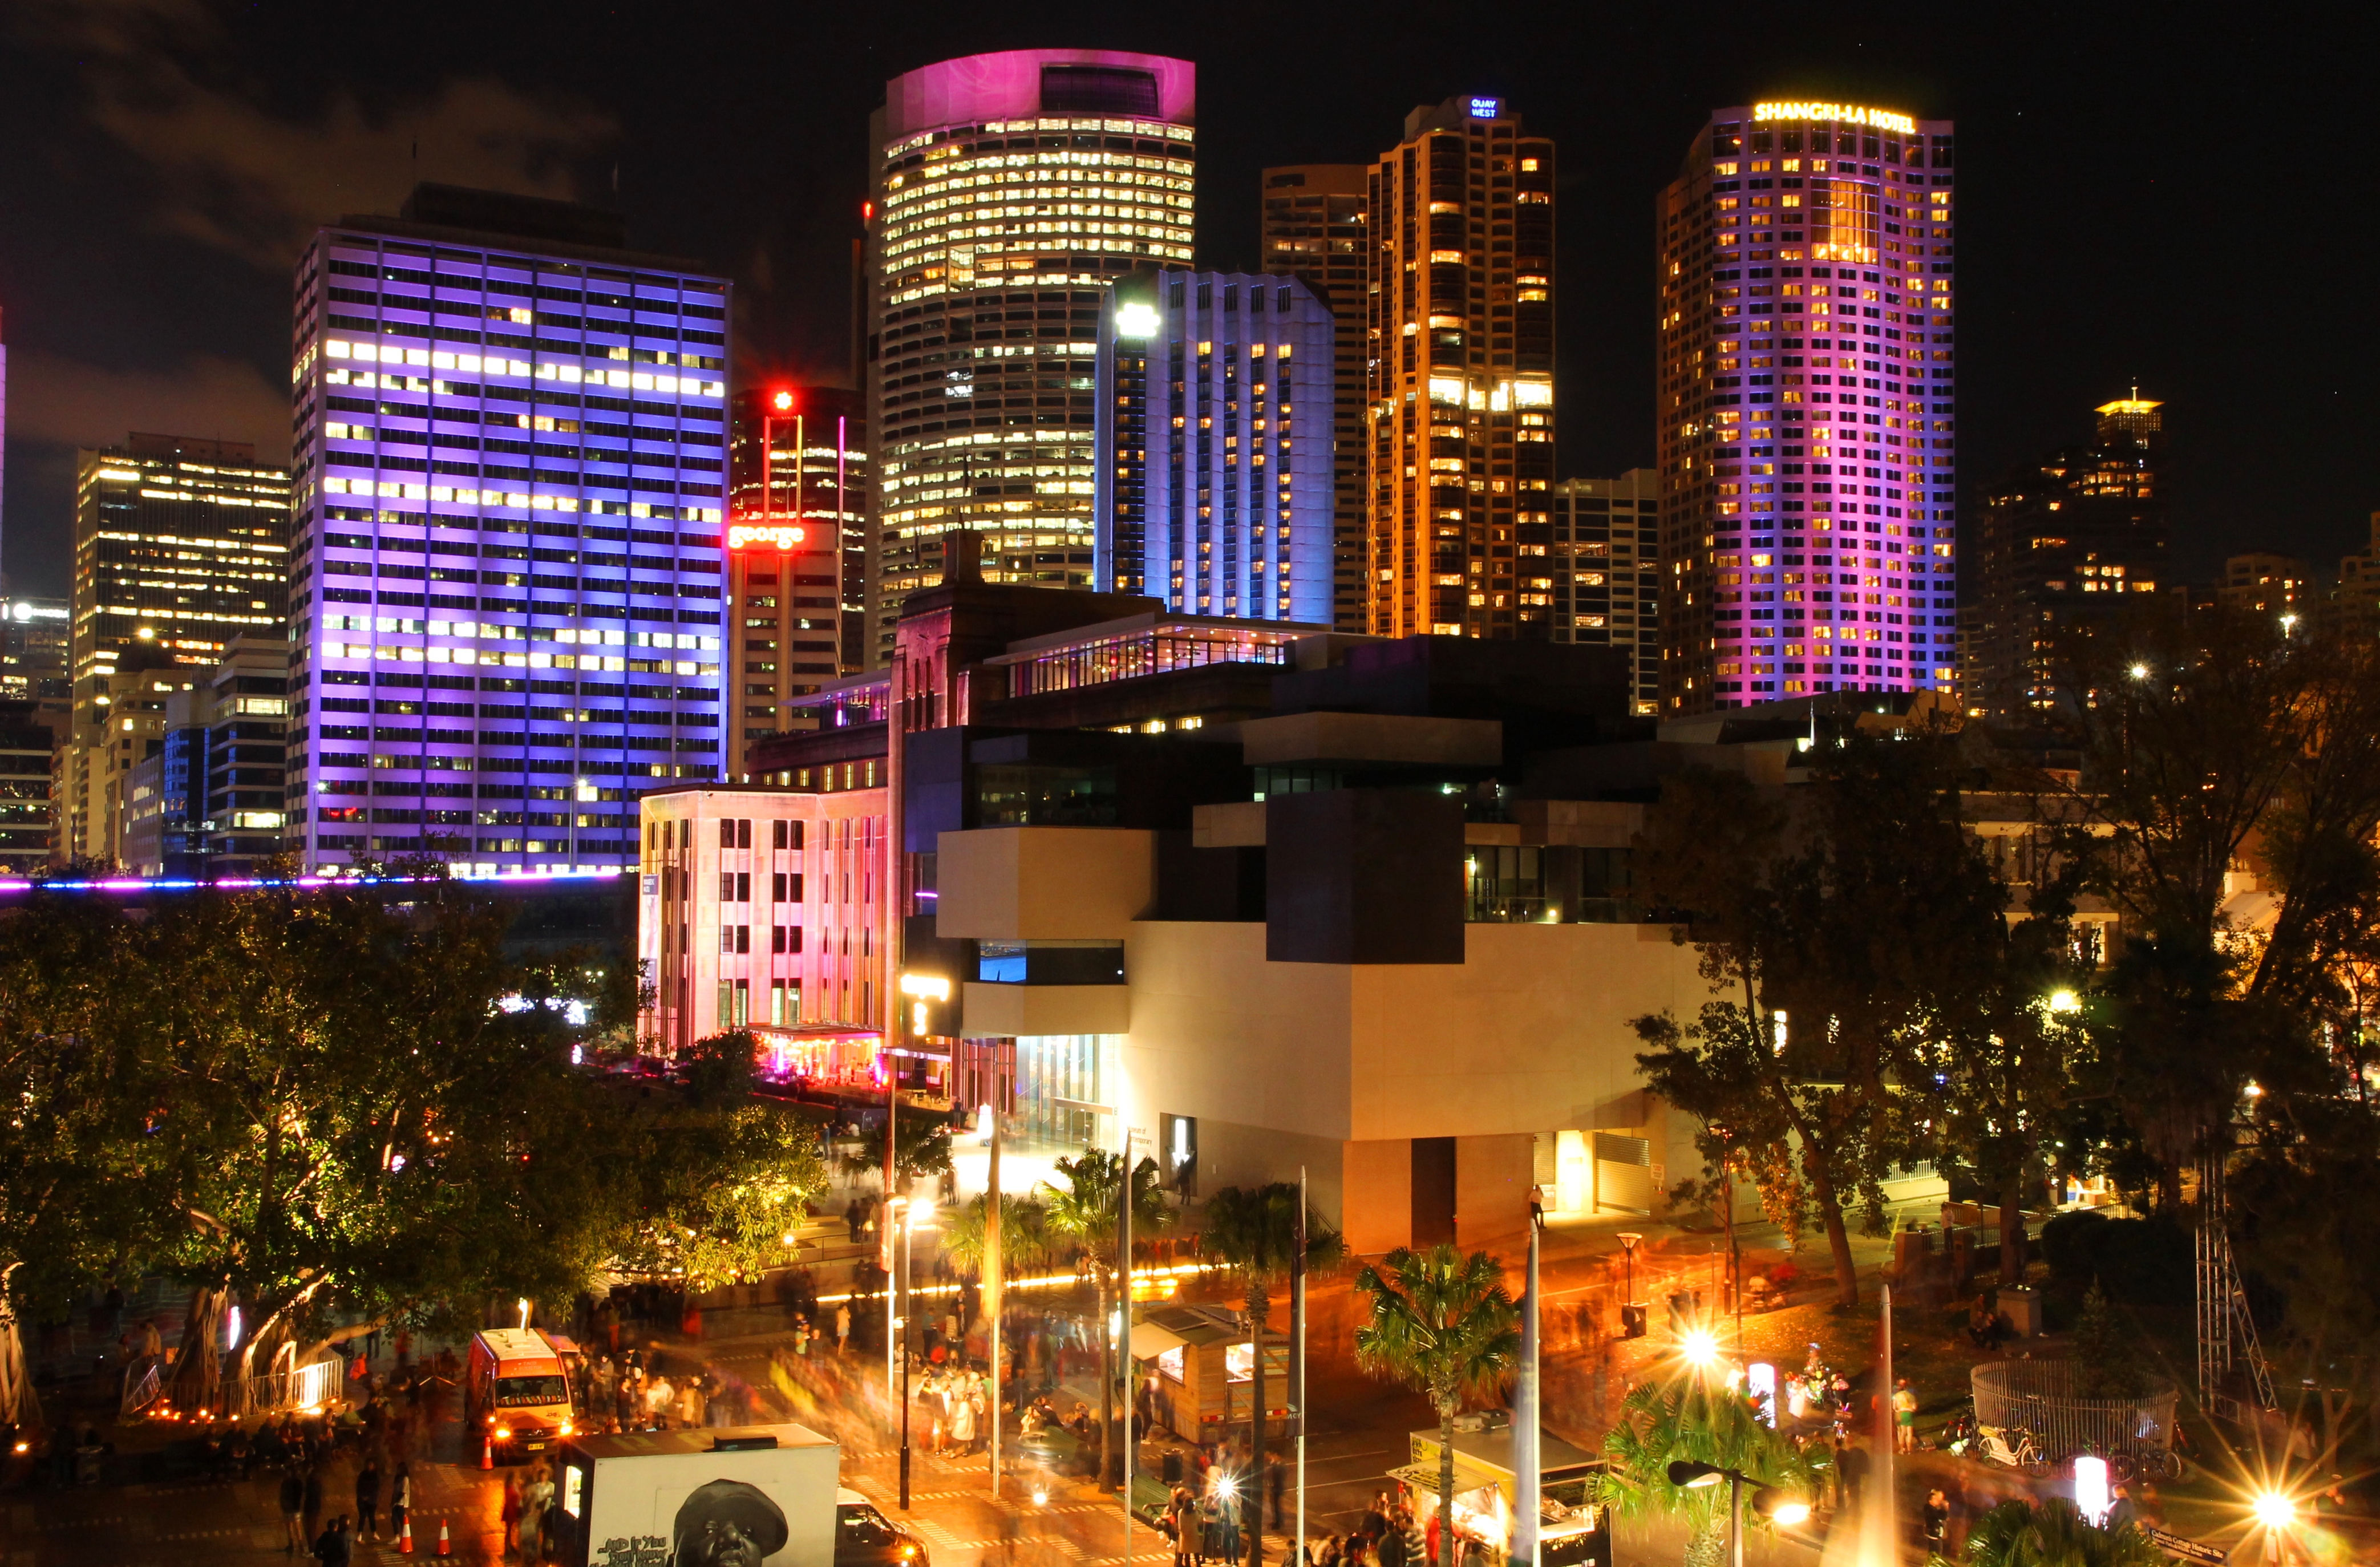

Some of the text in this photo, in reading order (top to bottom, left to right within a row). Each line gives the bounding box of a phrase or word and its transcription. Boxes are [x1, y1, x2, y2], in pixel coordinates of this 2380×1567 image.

[1471, 99, 1496, 108] QUAY
[1471, 108, 1495, 118] WEST
[1755, 103, 1915, 133] SHANGRI-LA HOTEL
[728, 525, 804, 549] george
[2192, 1543, 2212, 1555] Historic
[2212, 1549, 2224, 1558] Site
